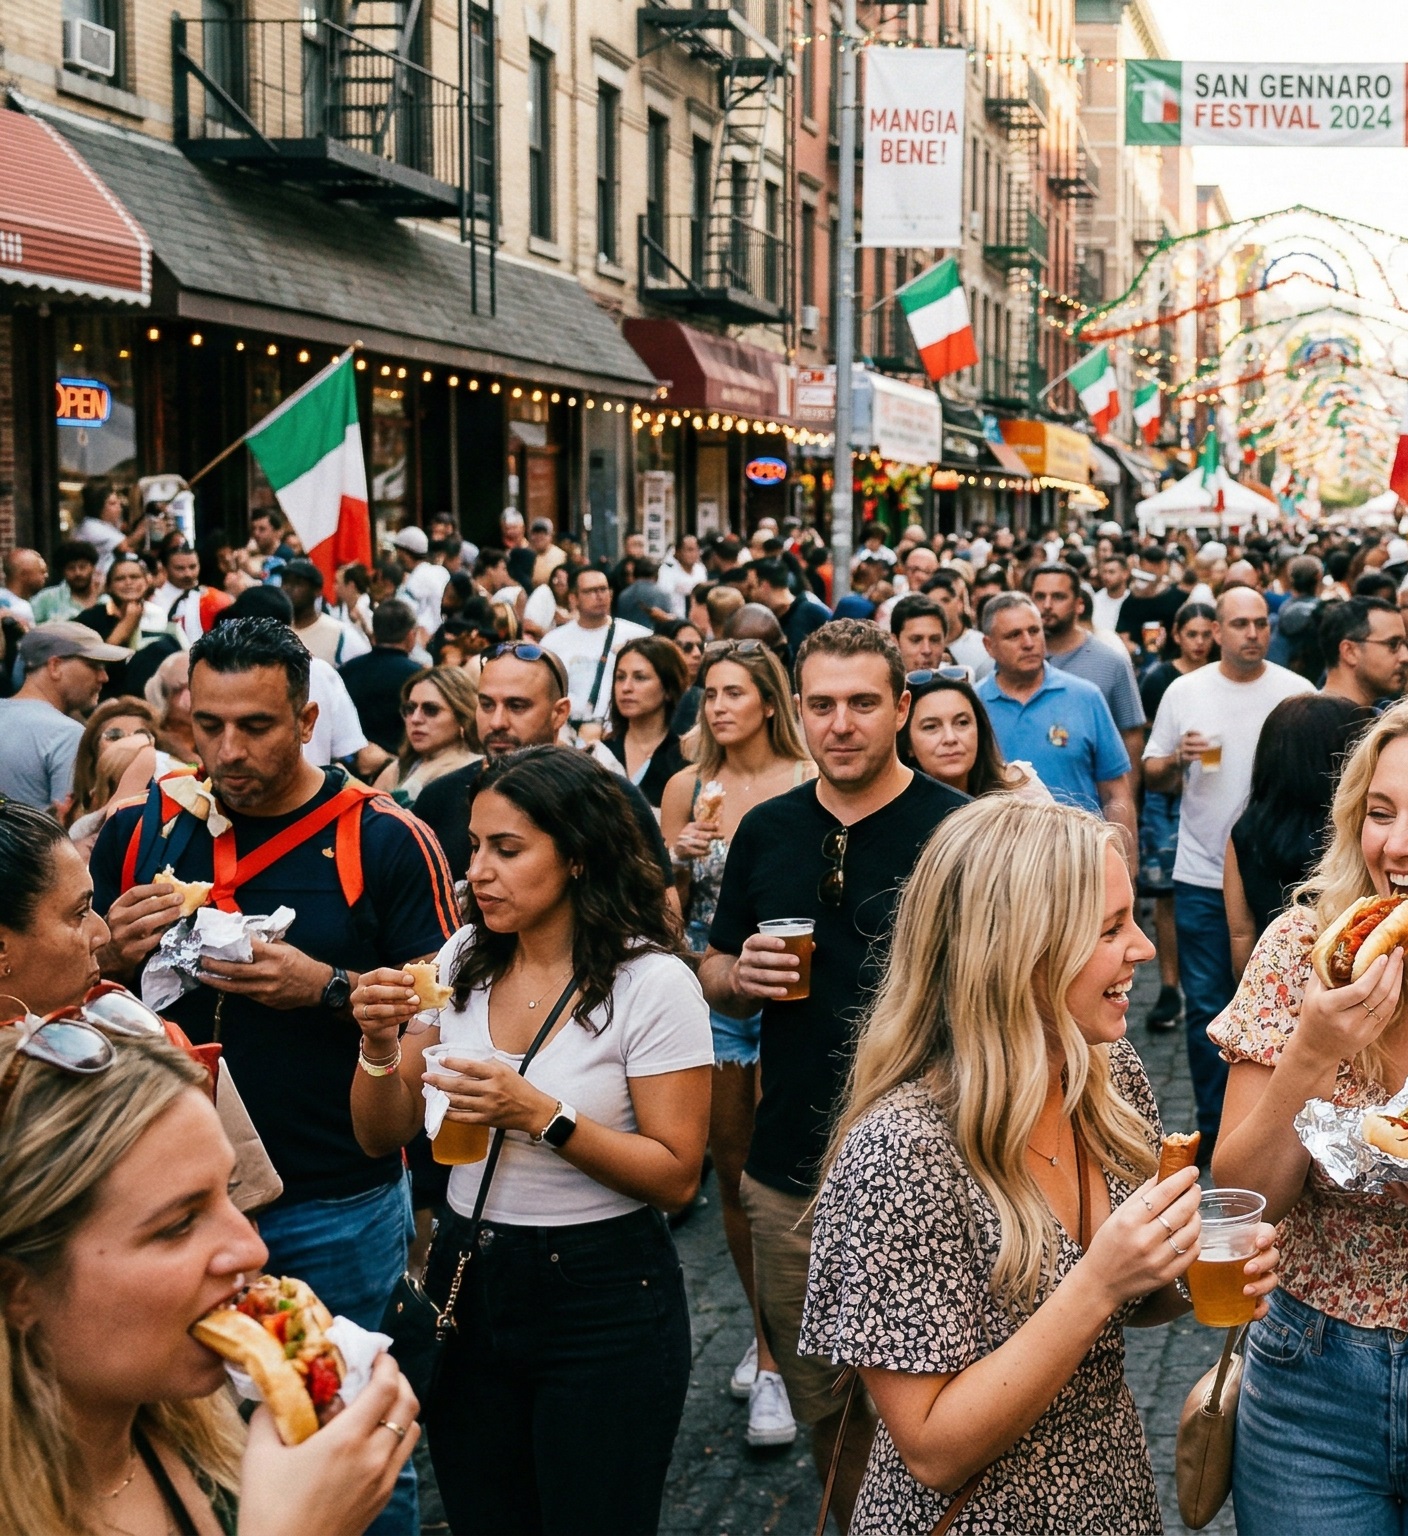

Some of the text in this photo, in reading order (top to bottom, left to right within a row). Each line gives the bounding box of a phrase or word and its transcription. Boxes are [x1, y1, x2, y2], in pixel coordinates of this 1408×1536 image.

[1195, 74, 1391, 99] SAN GENNARO
[869, 108, 958, 135] MANGIA
[1194, 103, 1392, 129] FESTIVAL 2024
[880, 139, 947, 165] BENE!
